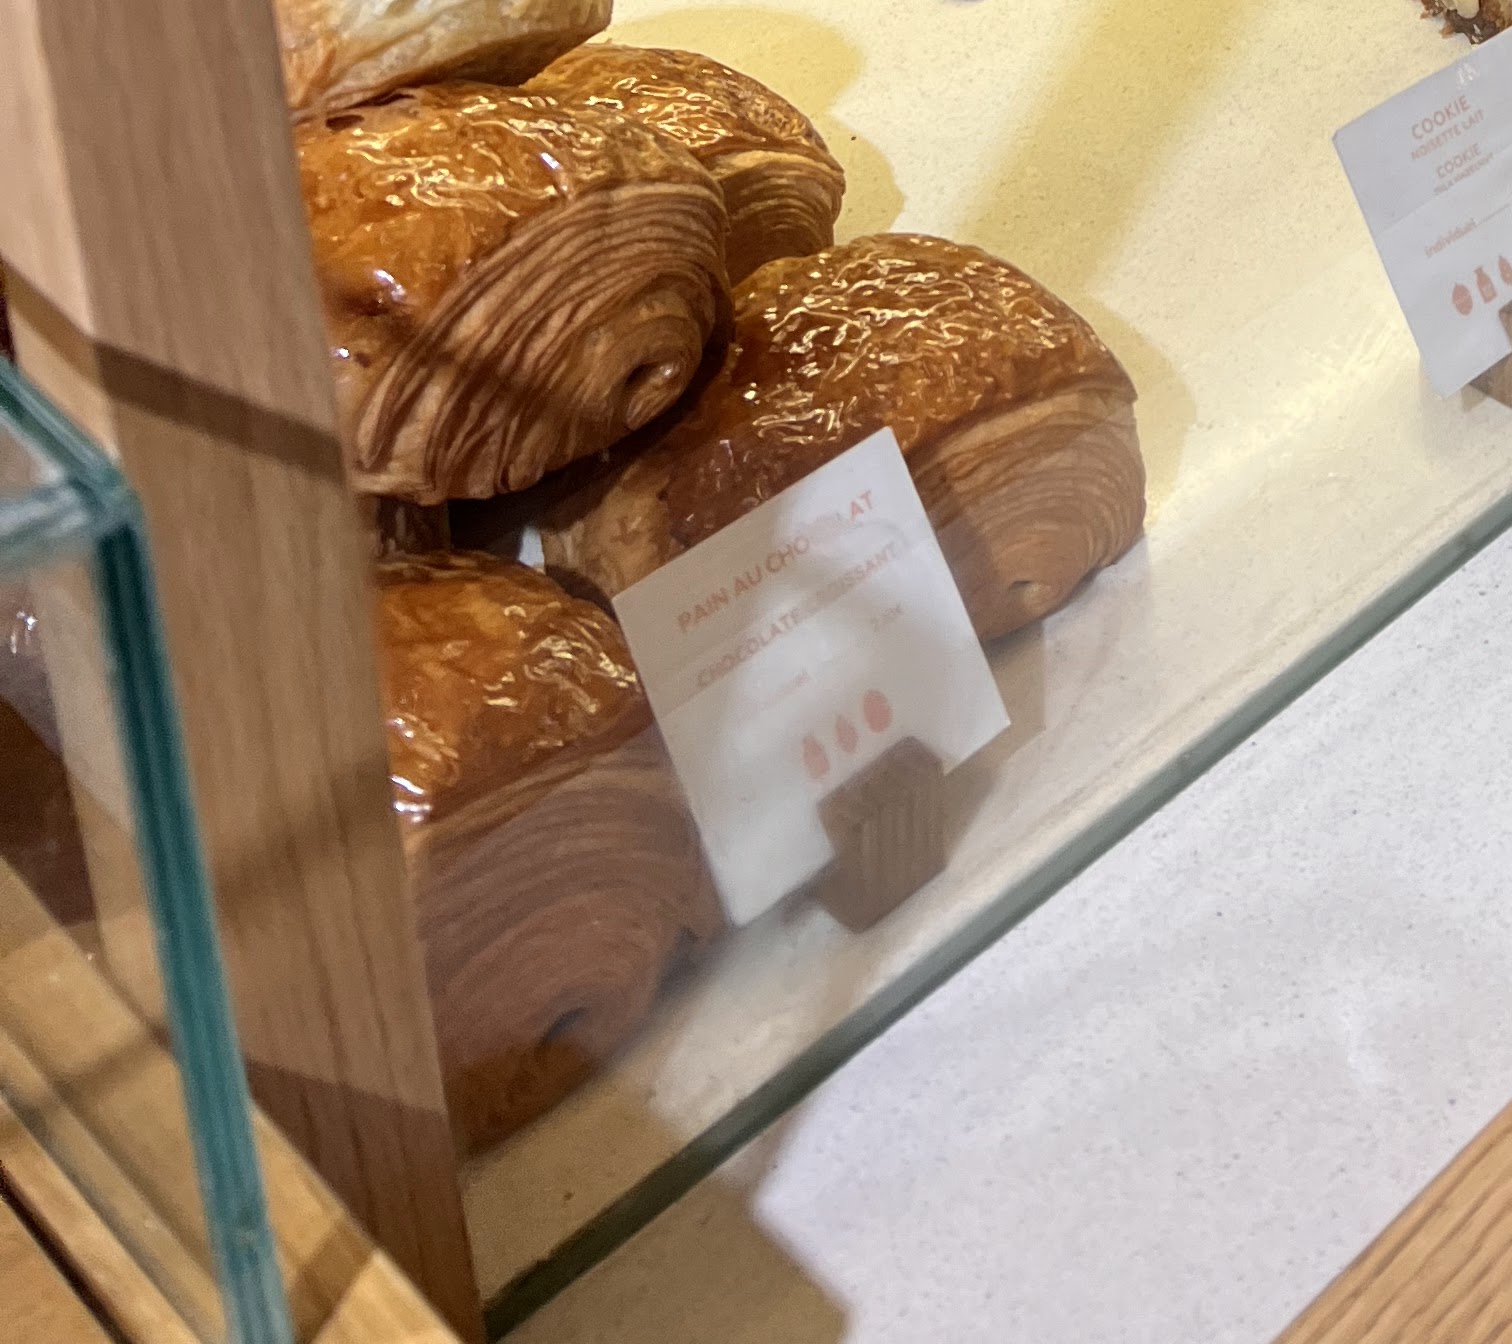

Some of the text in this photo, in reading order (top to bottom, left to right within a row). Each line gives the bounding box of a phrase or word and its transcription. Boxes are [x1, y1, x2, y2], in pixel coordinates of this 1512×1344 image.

[1411, 94, 1470, 140] COOKIE
[1411, 108, 1484, 160] NOISETTE LAIT
[1436, 142, 1481, 179] COOKIE
[676, 489, 874, 634] PAIN AU CHOAT
